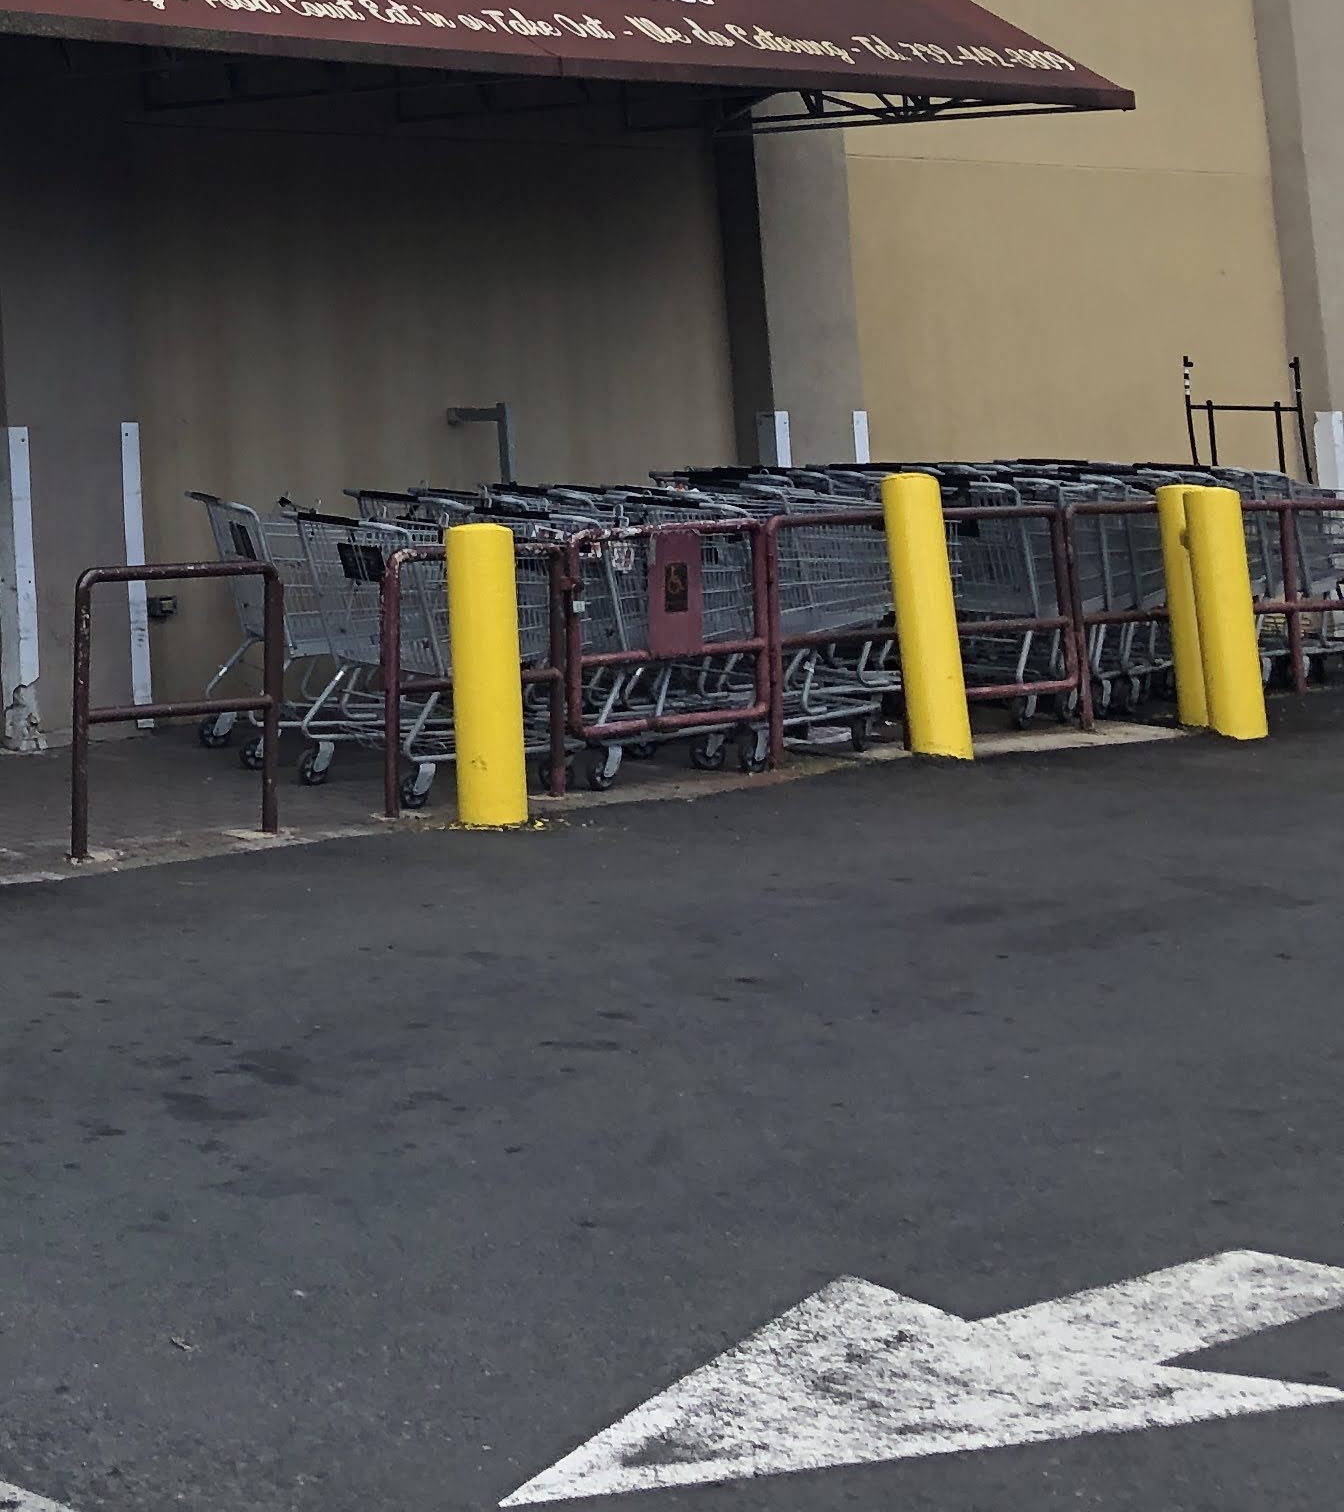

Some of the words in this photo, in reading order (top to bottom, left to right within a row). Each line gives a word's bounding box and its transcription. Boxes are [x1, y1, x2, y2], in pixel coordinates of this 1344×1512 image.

[413, 4, 457, 29] in
[457, 13, 497, 33] or
[481, 7, 563, 37] Take
[553, 13, 616, 40] Out
[624, 15, 692, 44] We
[683, 17, 736, 47] do
[724, 24, 856, 65] Catering
